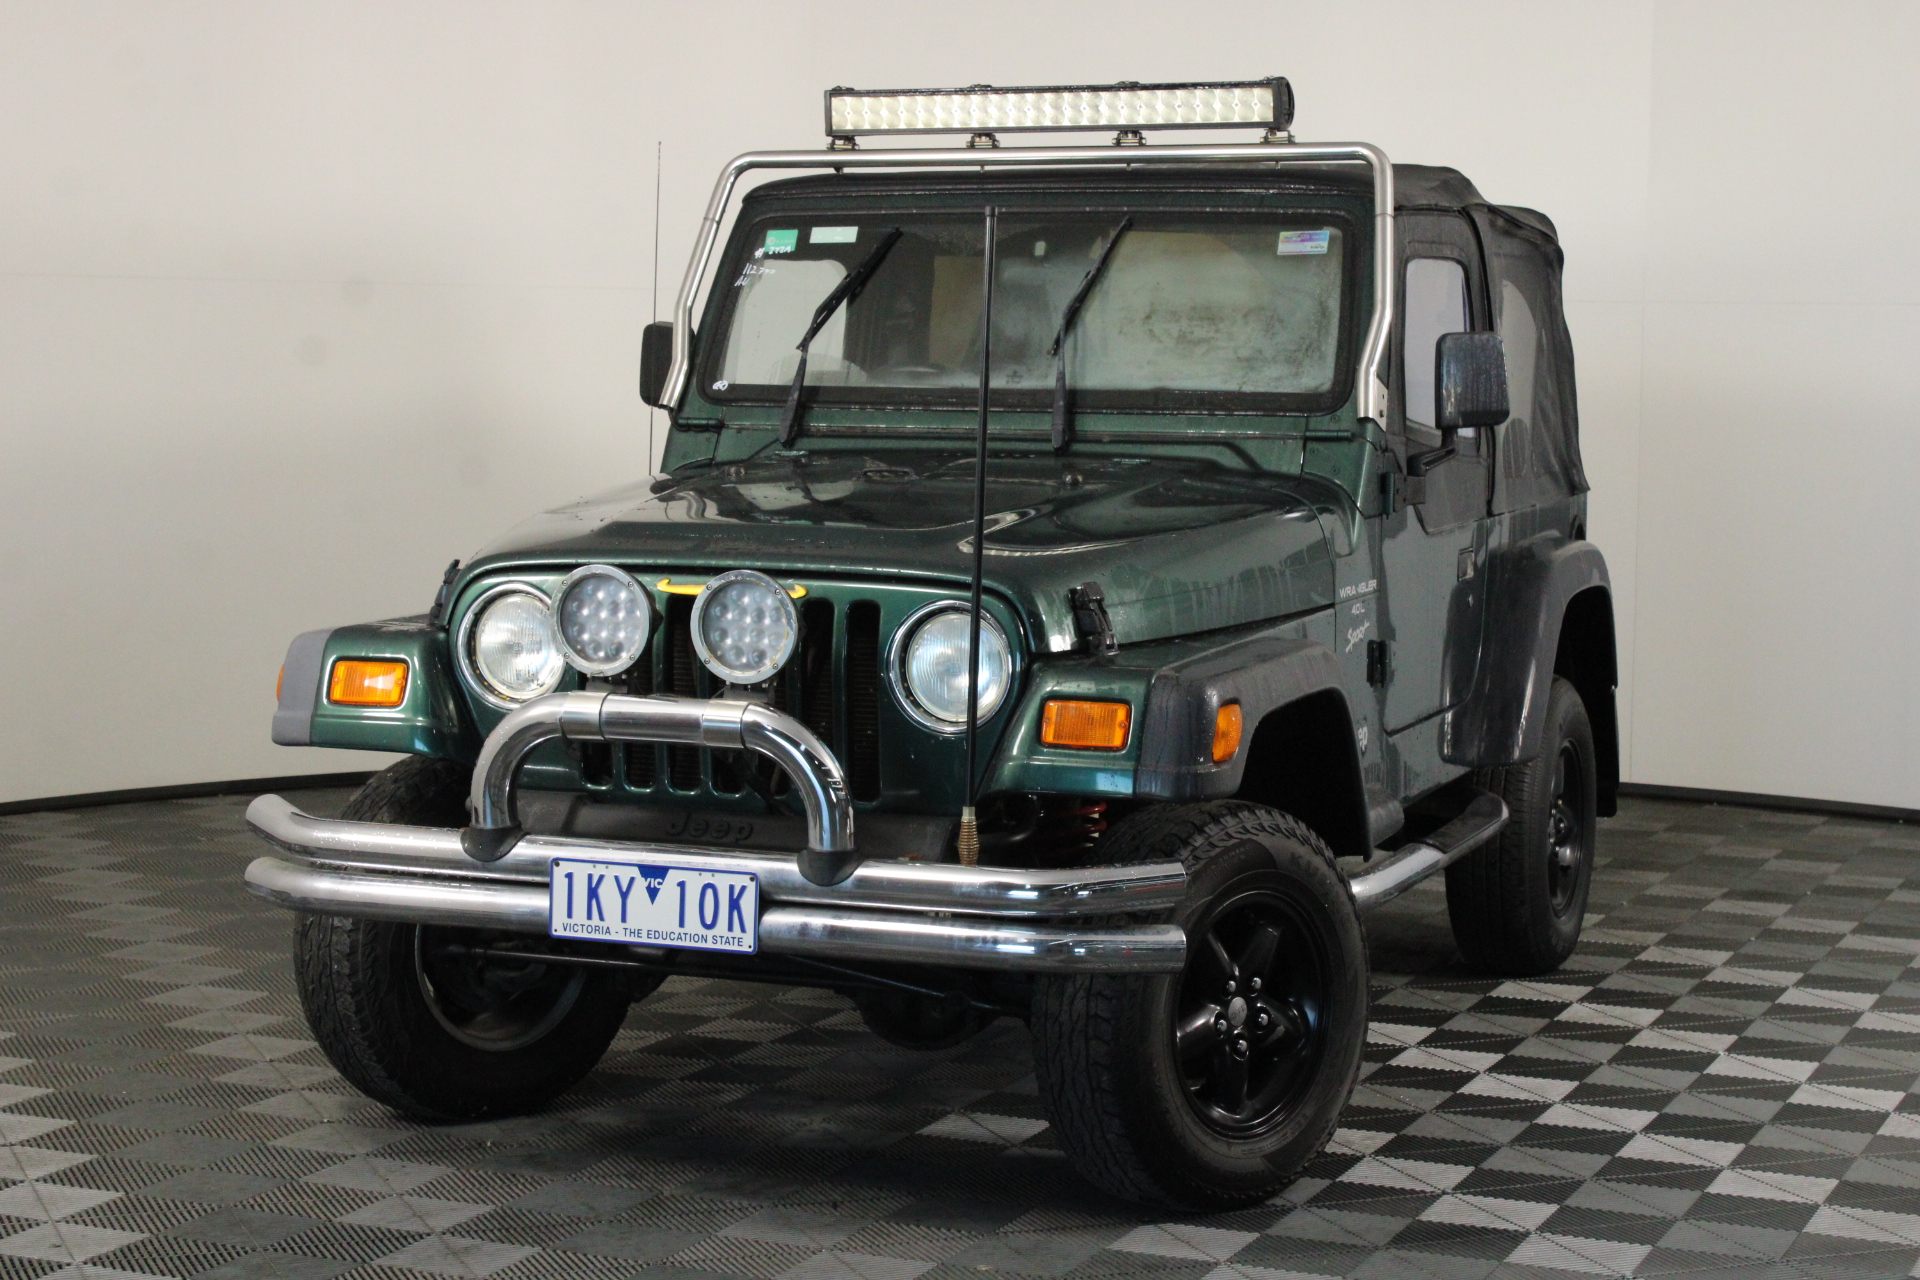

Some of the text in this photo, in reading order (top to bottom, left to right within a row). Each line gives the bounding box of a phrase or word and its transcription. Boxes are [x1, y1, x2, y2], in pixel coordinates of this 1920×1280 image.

[665, 812, 754, 843] Jeep
[564, 871, 636, 924] 1KY
[562, 922, 612, 936] VICTORIA
[623, 927, 643, 939] THE
[646, 929, 708, 945] EDUCATION
[711, 934, 744, 947] STATE
